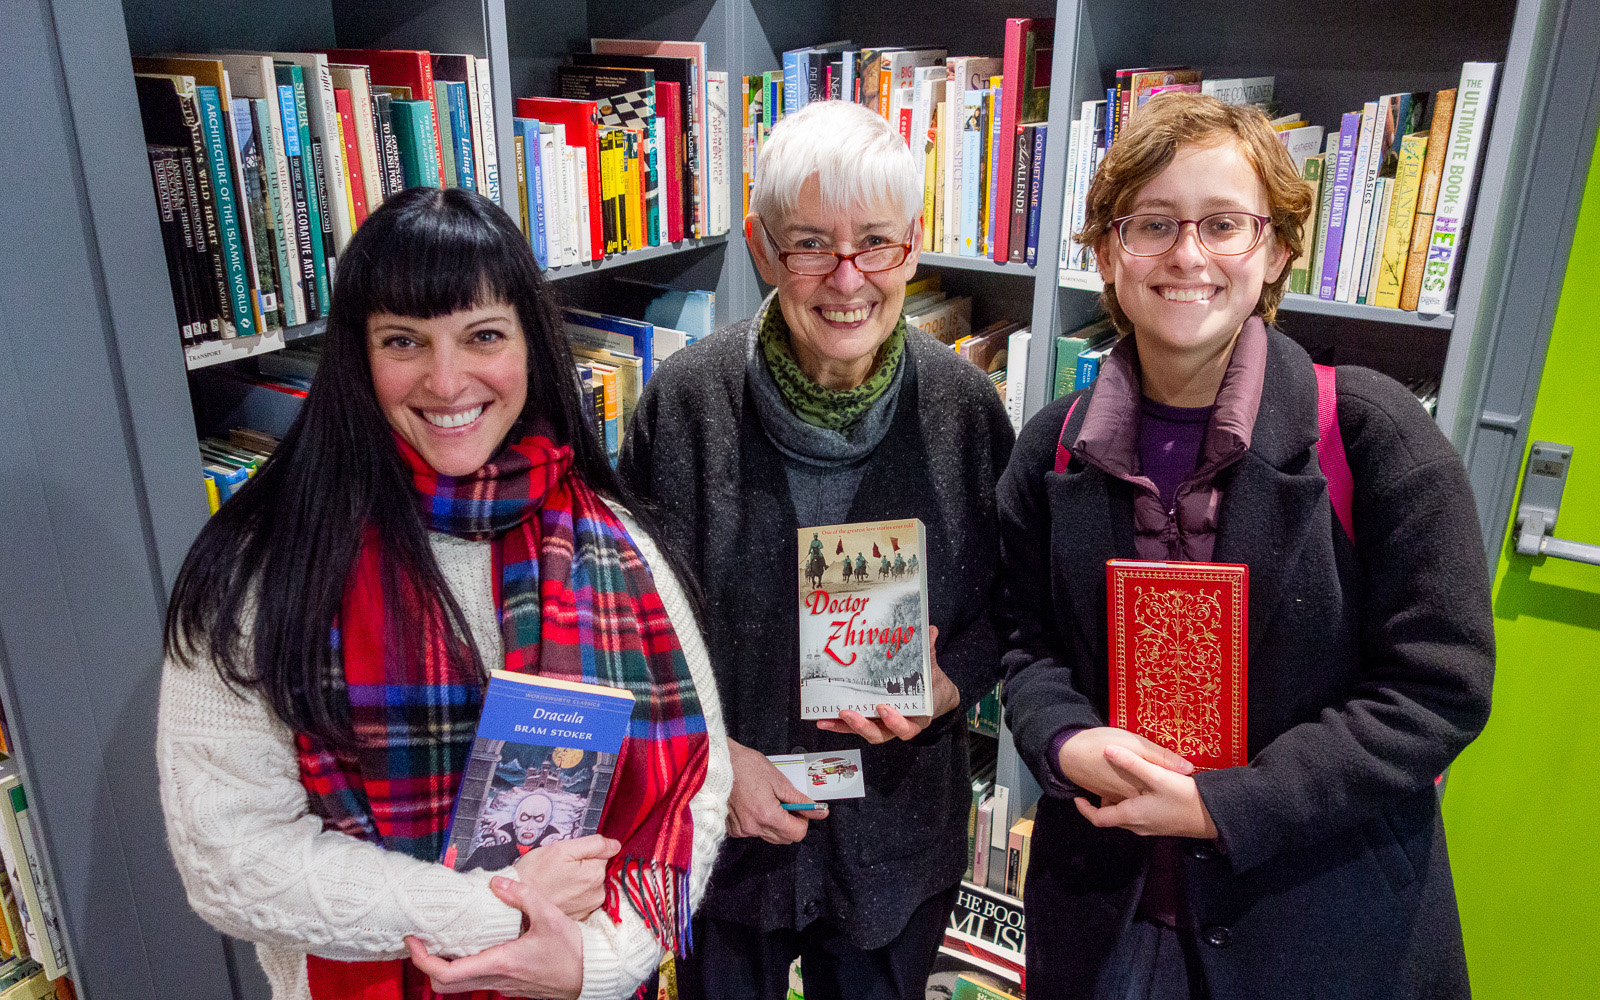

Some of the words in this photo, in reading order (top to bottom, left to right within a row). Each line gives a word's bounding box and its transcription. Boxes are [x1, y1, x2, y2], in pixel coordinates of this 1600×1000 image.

[424, 64, 432, 81] THE
[900, 66, 912, 78] BIG
[956, 65, 964, 96] Creative
[1466, 79, 1483, 88] THE
[295, 82, 309, 128] SILVER
[1216, 88, 1230, 102] THE
[1231, 84, 1272, 100] CONTAINER
[283, 90, 298, 153] MILLER'S
[360, 97, 370, 129] Modern
[365, 130, 374, 158] Scribes
[382, 122, 390, 134] TO
[479, 83, 496, 143] DICTIONARY
[954, 98, 963, 130] Cooking
[1452, 91, 1480, 161] ULTIMATE
[206, 103, 228, 186] ARCHITECTURE
[648, 118, 657, 145] Table
[687, 130, 695, 157] CLOSE
[1341, 134, 1352, 148] THE
[1369, 105, 1387, 166] PROPAGATION
[384, 134, 395, 169] ENGLISH
[459, 137, 473, 175] Living
[487, 144, 496, 158] OF
[648, 147, 659, 182] Games
[689, 160, 695, 172] UP
[709, 117, 721, 183] APPRENTICE
[714, 115, 726, 185] SAILMAKER'S
[968, 135, 976, 171] Deliciously
[1033, 134, 1043, 180] GOURMET
[1337, 150, 1352, 184] FRUGAL
[278, 156, 290, 208] AMERICAN
[294, 167, 302, 182] YEARS
[296, 182, 303, 190] OF
[465, 176, 474, 188] in
[534, 166, 543, 204] GUARDIAN
[953, 150, 963, 190] SPICES
[1321, 153, 1339, 211] GARDENING
[1355, 146, 1369, 194] PERENNIALS
[1364, 169, 1377, 205] BASICS
[1443, 165, 1465, 204] BOOK
[156, 162, 172, 220] SURREALISTS
[185, 159, 205, 251] POST-IMPRESSIONISTS
[220, 187, 230, 202] OF
[318, 177, 331, 230] MACKINTOSH
[1015, 163, 1026, 214] ALLENDE
[1031, 182, 1039, 207] GAME
[1330, 184, 1347, 228] GARDENER
[1394, 162, 1419, 230] PLANTS
[199, 169, 211, 200] WILD
[205, 205, 218, 246] HEART
[223, 204, 234, 225] THE
[536, 205, 544, 234] 2011
[1443, 206, 1454, 214] OF
[296, 201, 310, 256] DECORATIVE
[1318, 214, 1329, 254] HANDBOOK
[213, 253, 224, 279] PETER
[226, 227, 241, 272] ISLAMIC
[1424, 215, 1458, 291] HERBS
[303, 258, 314, 280] ARTS
[234, 274, 248, 314] WORLD
[1420, 296, 1440, 305] Digest
[918, 316, 946, 334] OOD
[189, 350, 221, 361] TRANSPORT
[847, 527, 865, 535] greatest
[805, 590, 870, 615] Doctor
[824, 612, 914, 666] Zhivago
[533, 708, 584, 724] Dracula
[805, 704, 841, 713] BORIS
[848, 702, 918, 710] PASTNAK
[514, 724, 547, 735] BRAM
[550, 729, 593, 740] STOKER
[956, 890, 982, 913] HE
[983, 900, 1025, 931] BOO
[950, 910, 1025, 955] MUSI
